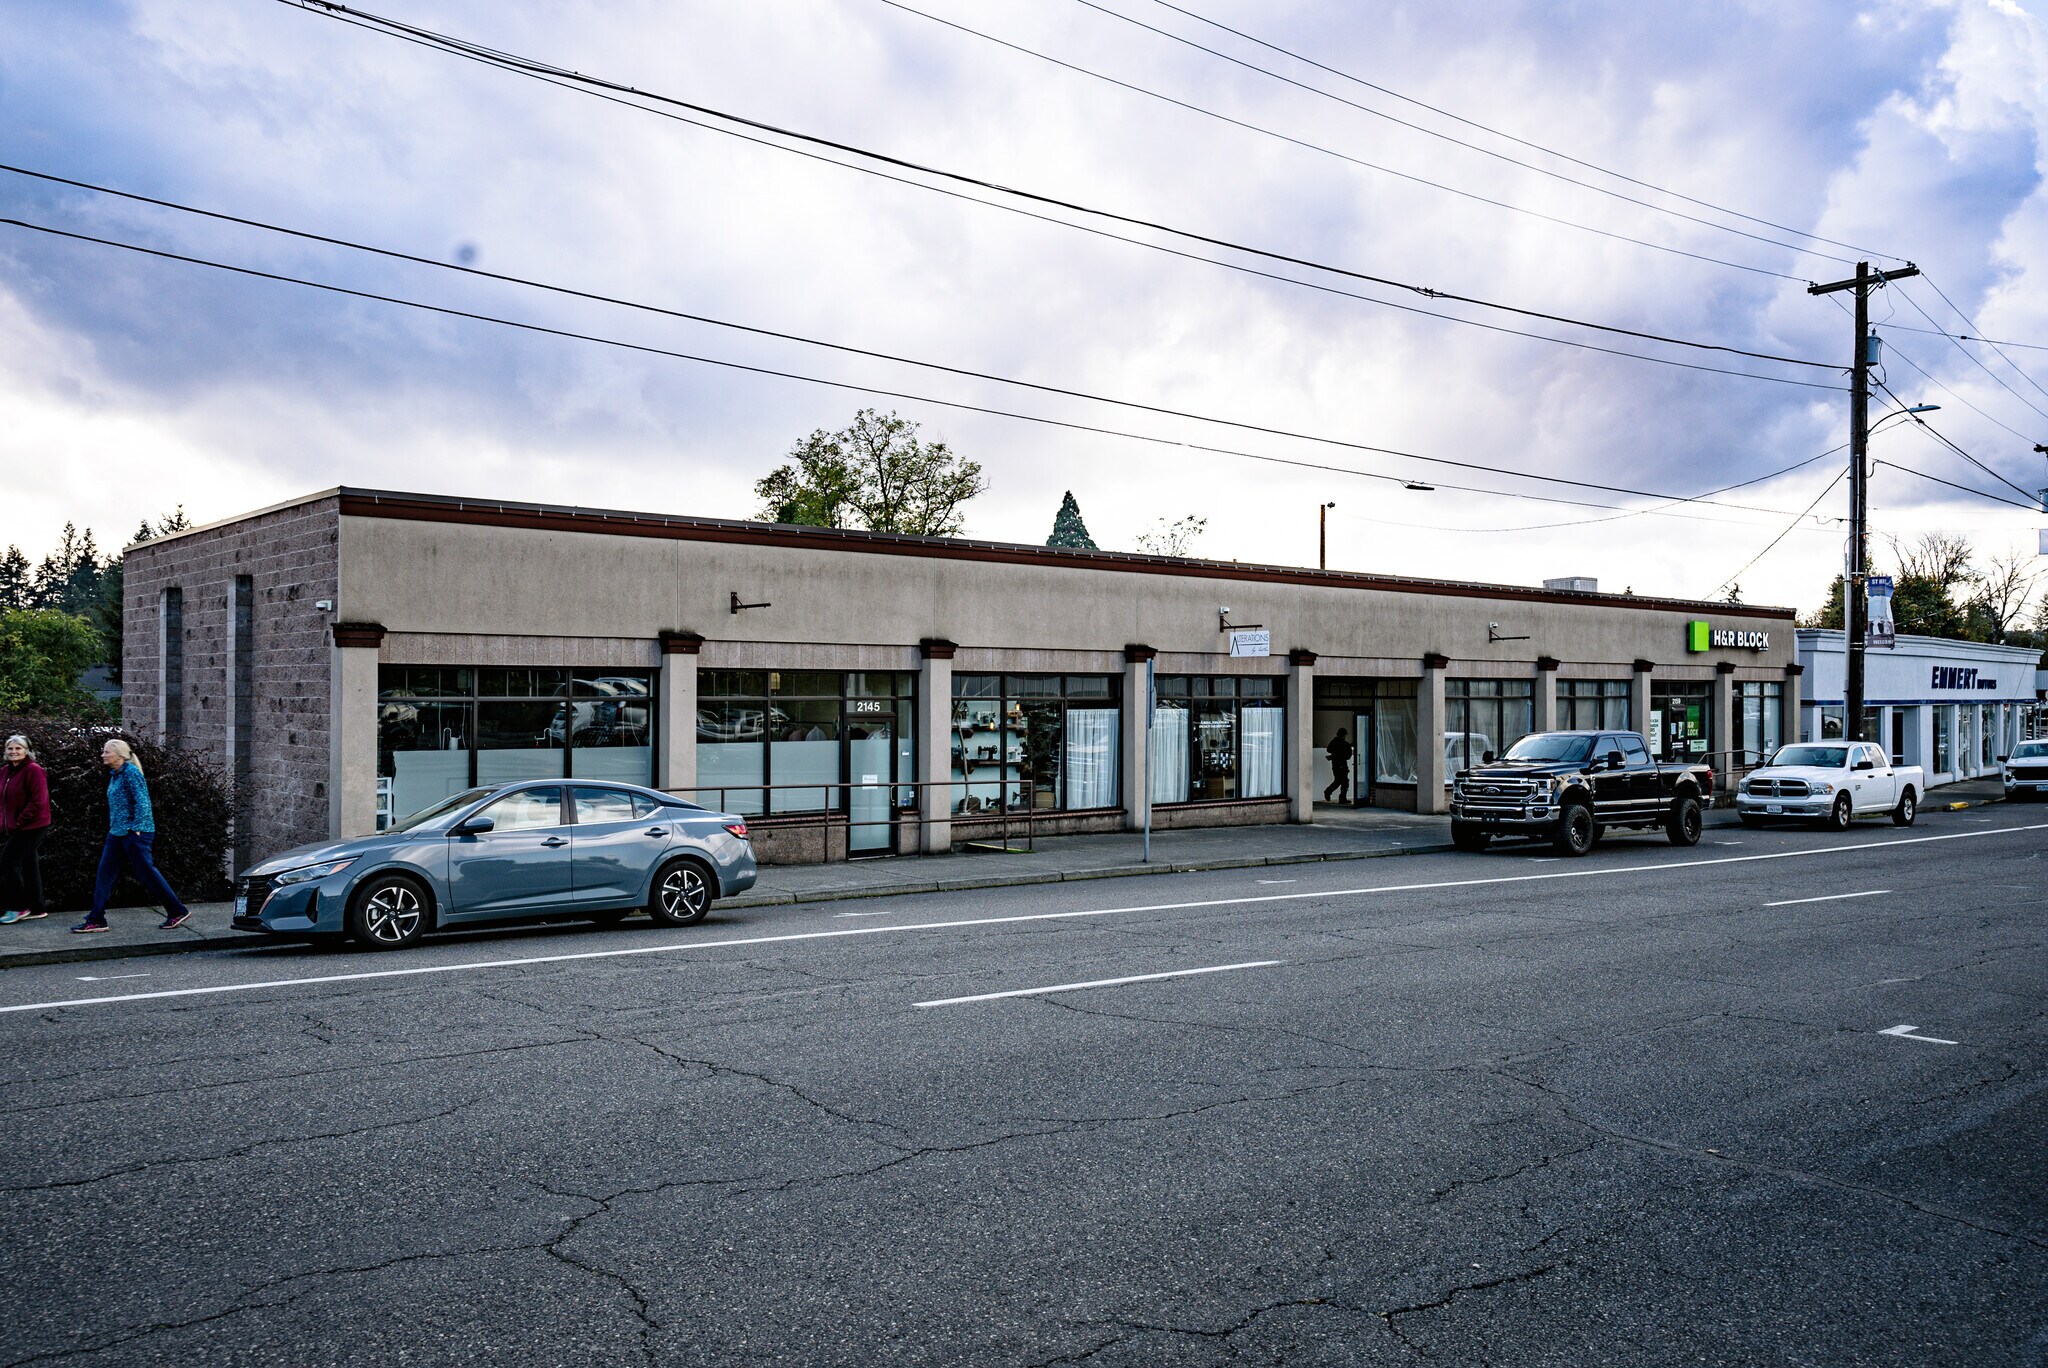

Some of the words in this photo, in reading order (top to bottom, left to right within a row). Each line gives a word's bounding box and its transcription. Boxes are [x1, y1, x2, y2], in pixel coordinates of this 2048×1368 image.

[1230, 633, 1269, 655] ALTERATIONS
[1714, 629, 1735, 647] H&R
[1737, 630, 1769, 648] BLOCK
[1931, 665, 1979, 690] EMMERT
[857, 701, 881, 712] 2145
